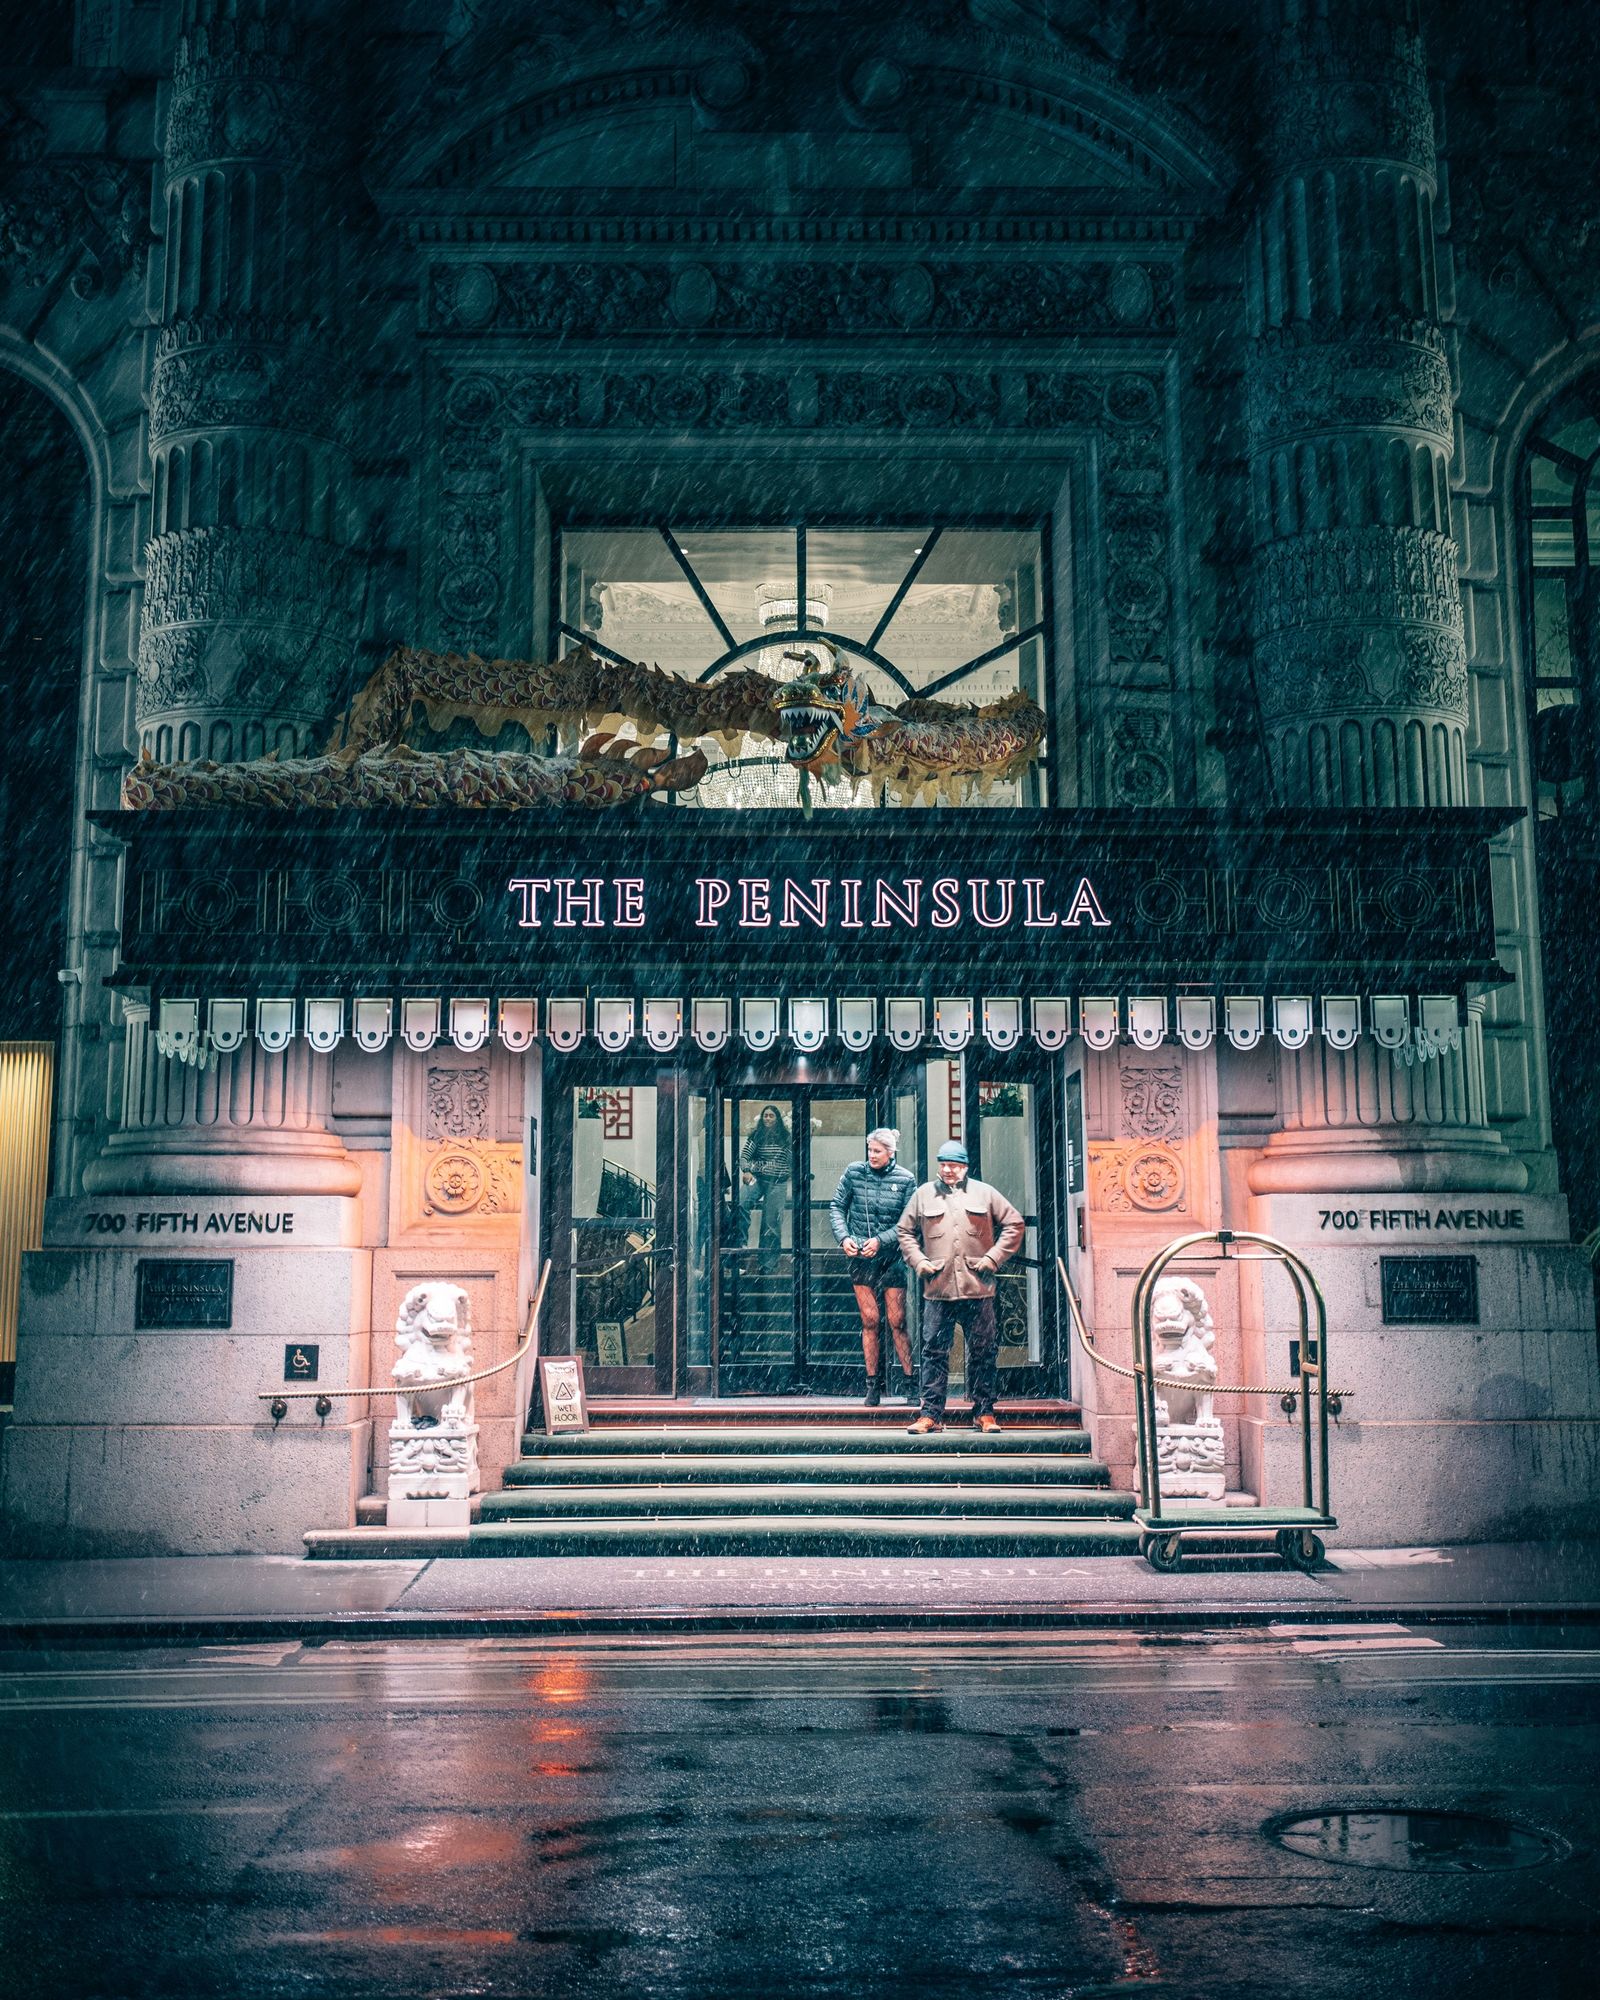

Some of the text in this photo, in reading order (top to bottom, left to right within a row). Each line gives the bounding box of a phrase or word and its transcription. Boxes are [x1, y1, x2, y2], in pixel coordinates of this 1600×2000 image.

[508, 877, 1112, 928] THE PENINSULA
[84, 1212, 295, 1234] 700 FIFTH AVENUE
[1318, 1208, 1526, 1231] 700 FIFTH AVENUE
[170, 1283, 224, 1293] PENINSULA
[557, 1404, 573, 1413] WET
[554, 1413, 579, 1422] FLOOR
[623, 1567, 1095, 1578] THE PENINSULA
